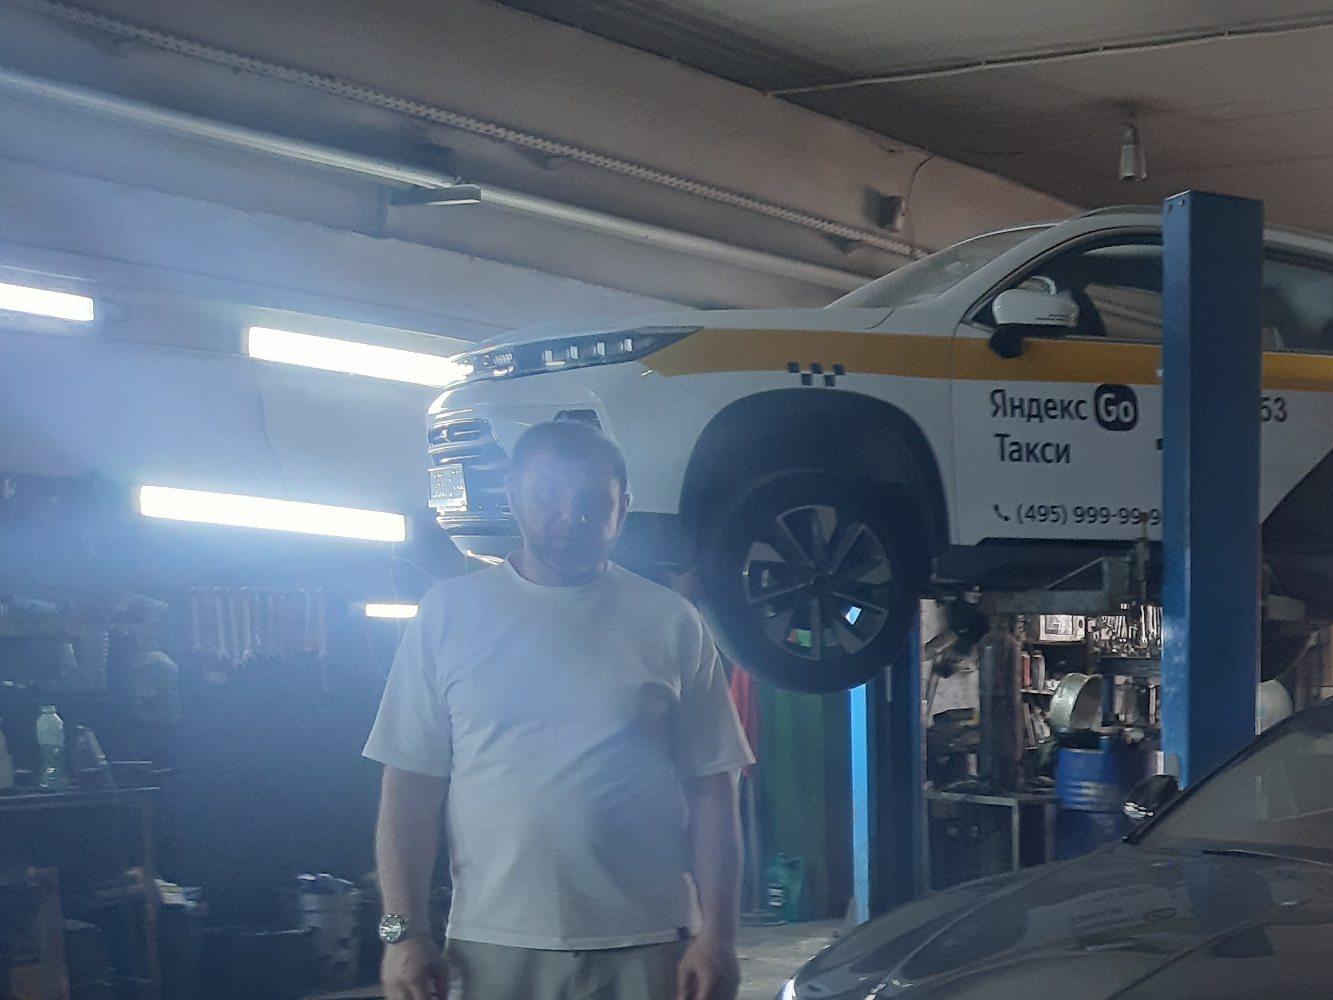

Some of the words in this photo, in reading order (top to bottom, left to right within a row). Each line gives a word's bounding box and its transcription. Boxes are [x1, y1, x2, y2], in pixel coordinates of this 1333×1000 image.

[990, 388, 1088, 423] Яндекс
[1101, 393, 1136, 422] Go
[995, 433, 1071, 464] Такси
[1017, 503, 1068, 525] (495)
[1073, 506, 1161, 525] 999-999
